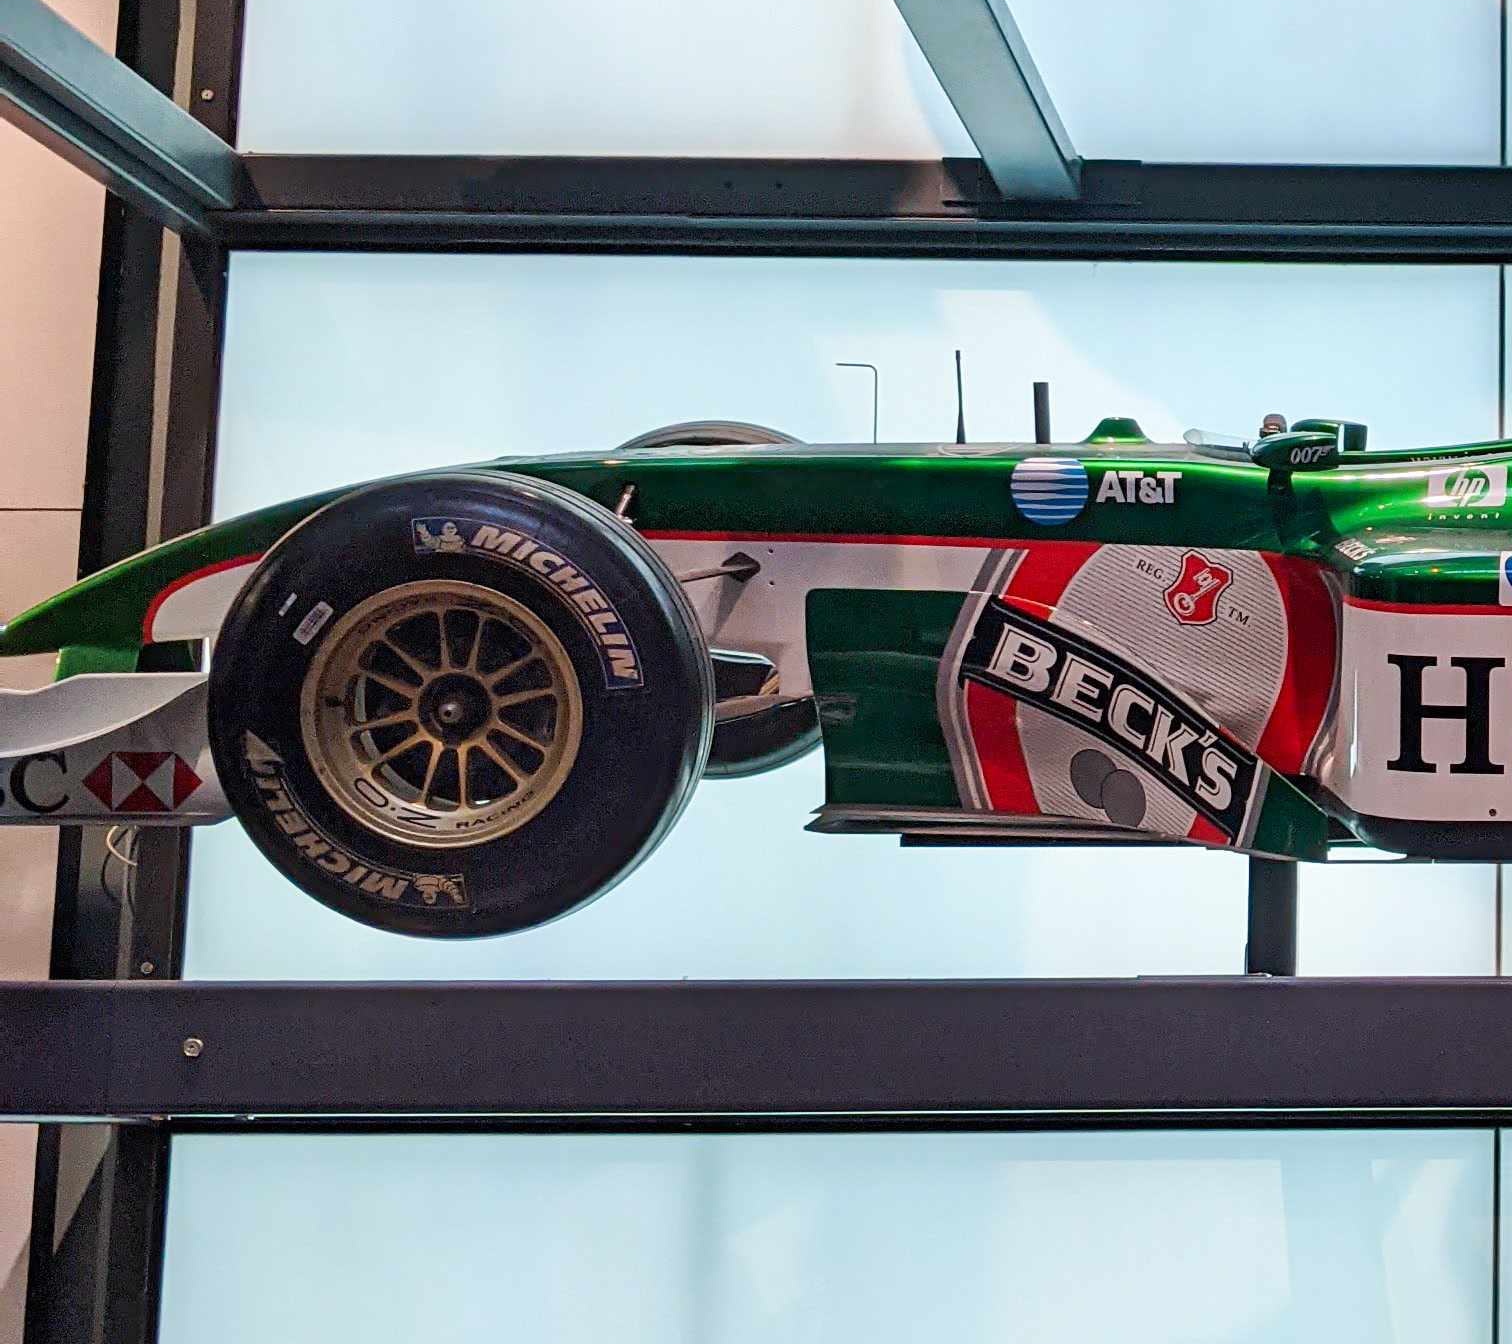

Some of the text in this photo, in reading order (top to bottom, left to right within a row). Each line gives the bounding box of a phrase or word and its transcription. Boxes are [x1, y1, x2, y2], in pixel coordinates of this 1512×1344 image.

[1289, 444, 1324, 466] 007
[1095, 469, 1183, 505] AT&T
[1426, 511, 1502, 522] invent
[1134, 557, 1169, 584] REG.
[471, 524, 640, 684] MICHELIN
[985, 622, 1239, 811] BECK'S
[455, 790, 536, 829] RACING
